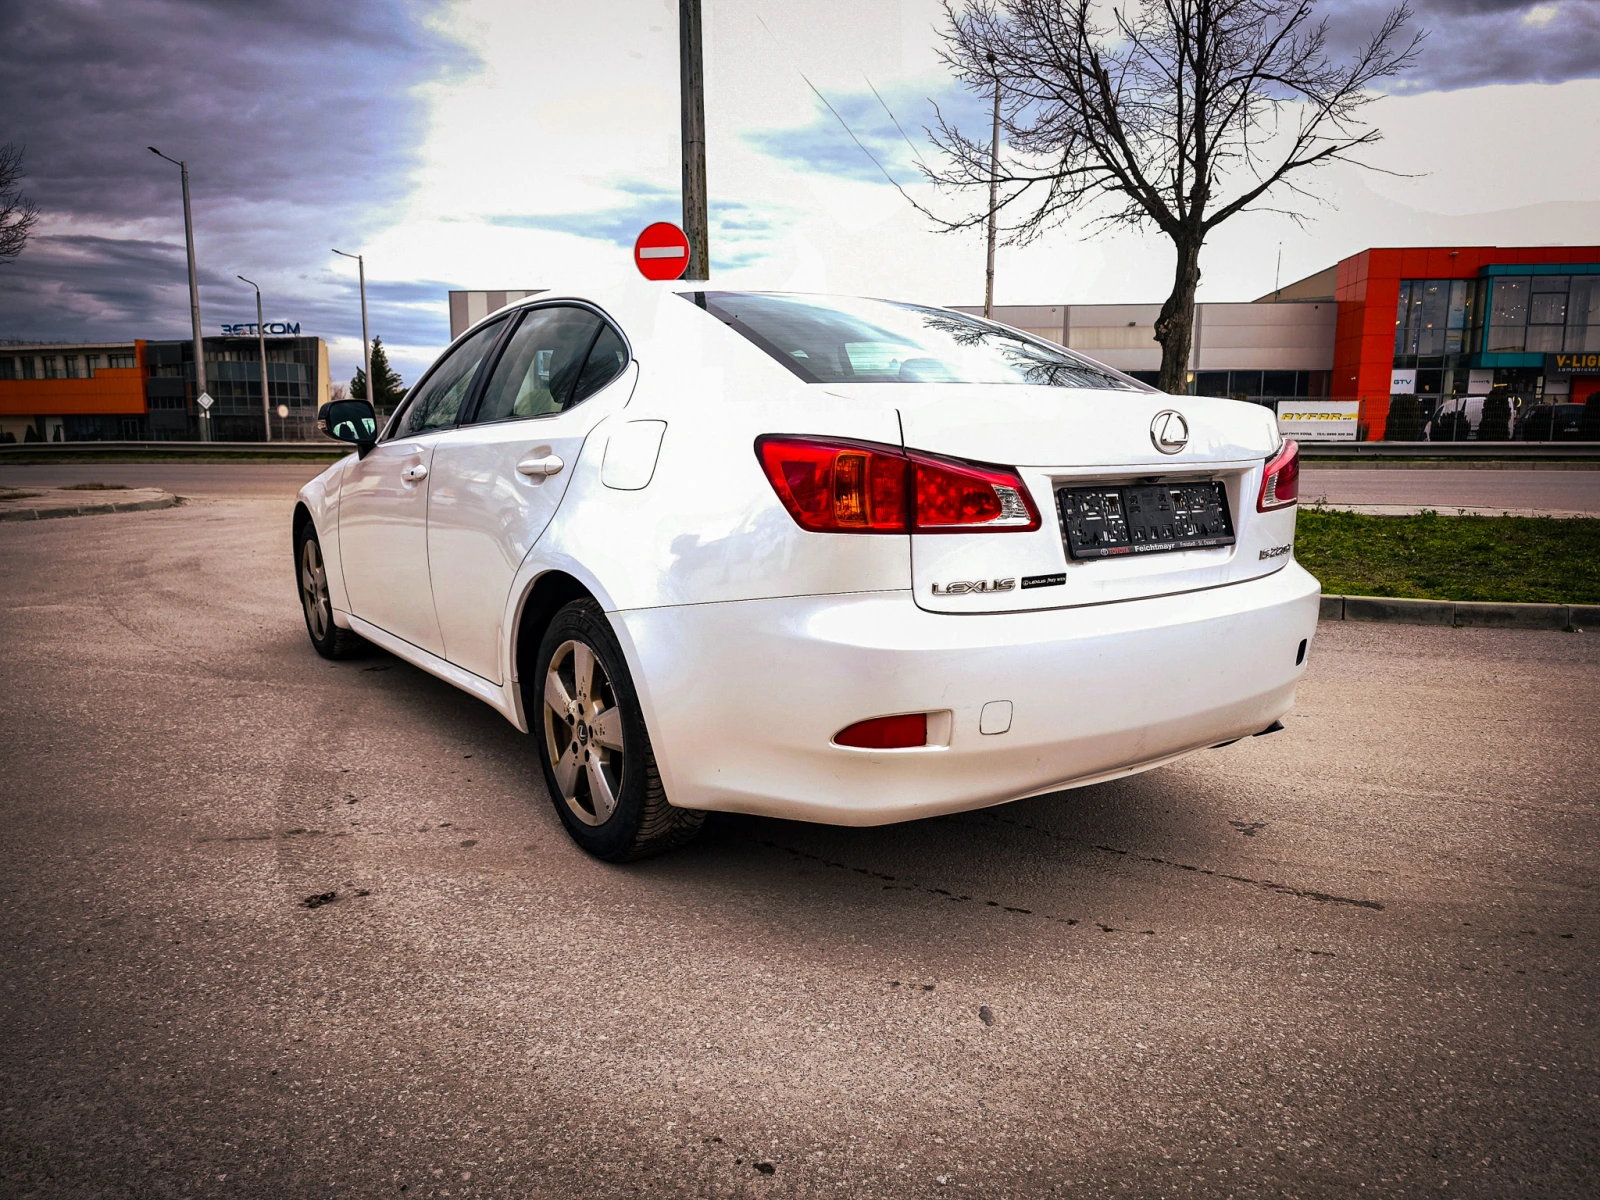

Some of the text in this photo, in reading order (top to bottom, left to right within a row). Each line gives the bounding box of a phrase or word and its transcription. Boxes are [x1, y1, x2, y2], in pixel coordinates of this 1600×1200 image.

[1109, 547, 1129, 555] TOYOTA
[1134, 542, 1175, 553] Feichtmayr
[932, 578, 1016, 596] LEXUS
